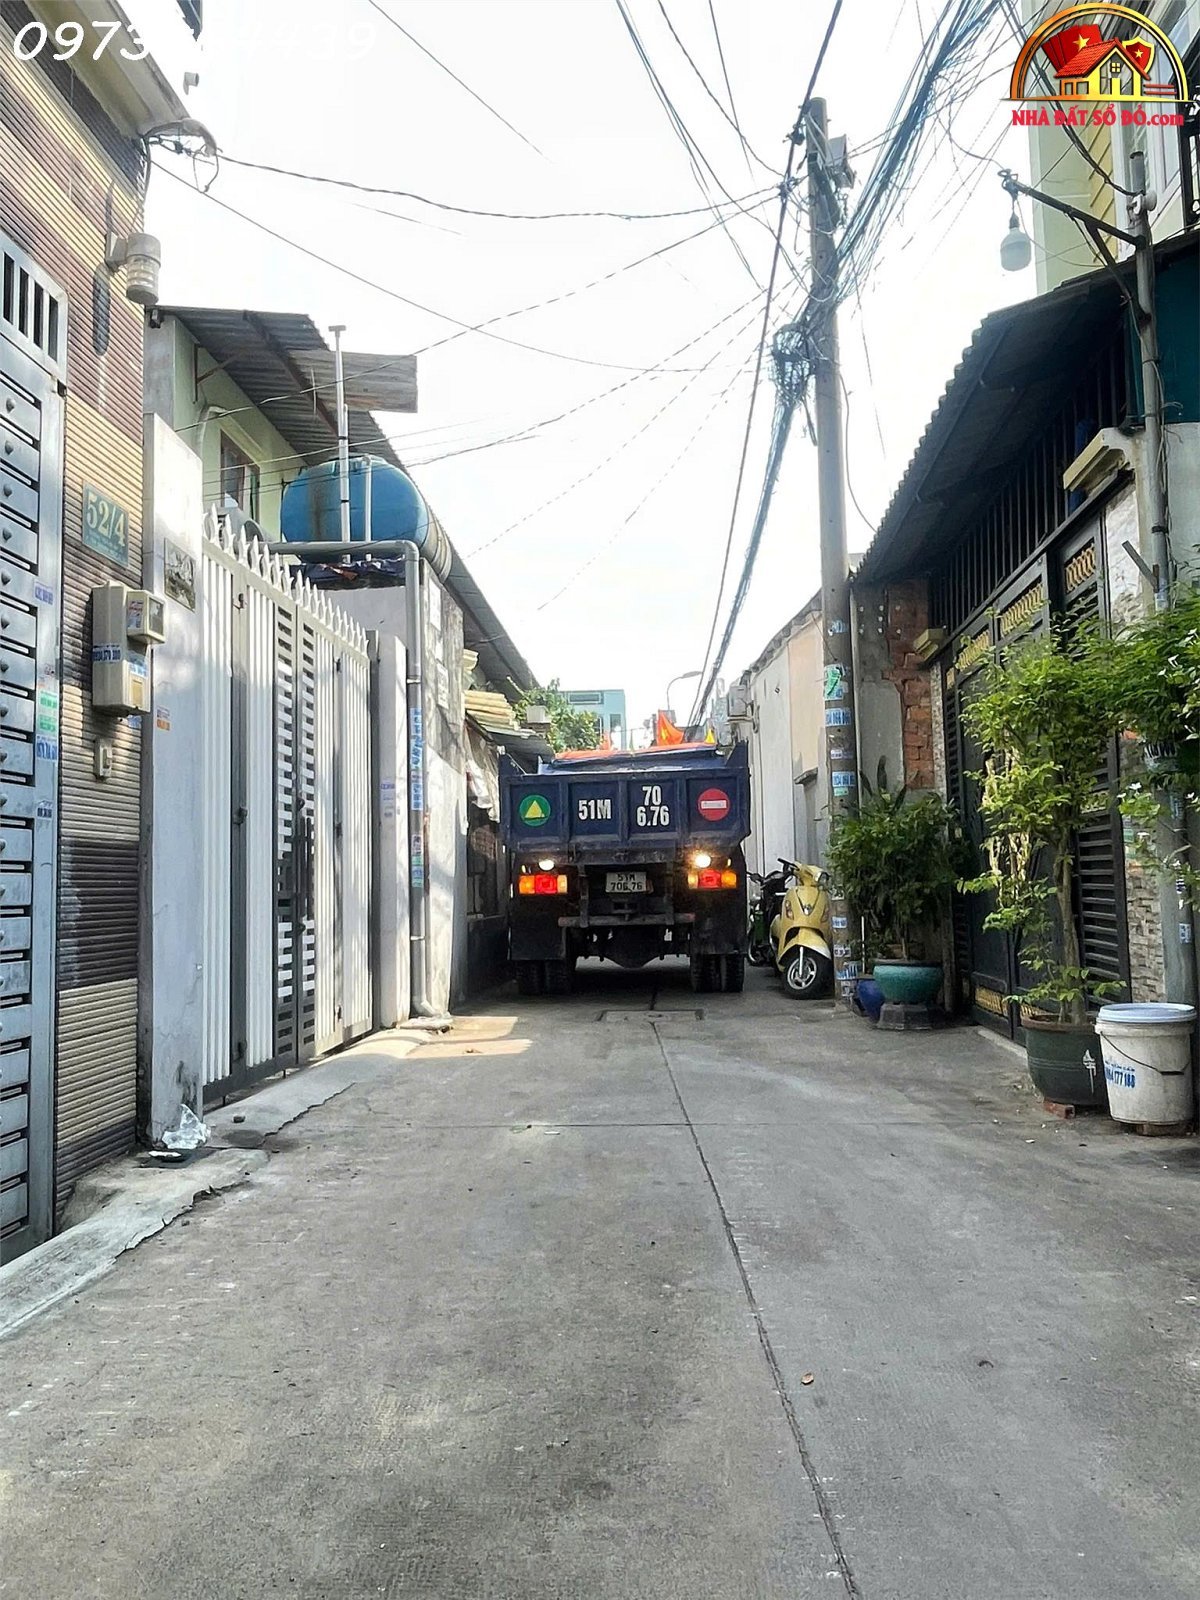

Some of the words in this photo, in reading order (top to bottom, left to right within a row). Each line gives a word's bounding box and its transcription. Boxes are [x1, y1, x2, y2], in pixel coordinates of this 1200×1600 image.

[86, 490, 126, 547] 52/4
[642, 785, 662, 806] 70
[578, 799, 612, 820] 51M
[636, 806, 670, 827] 6.76
